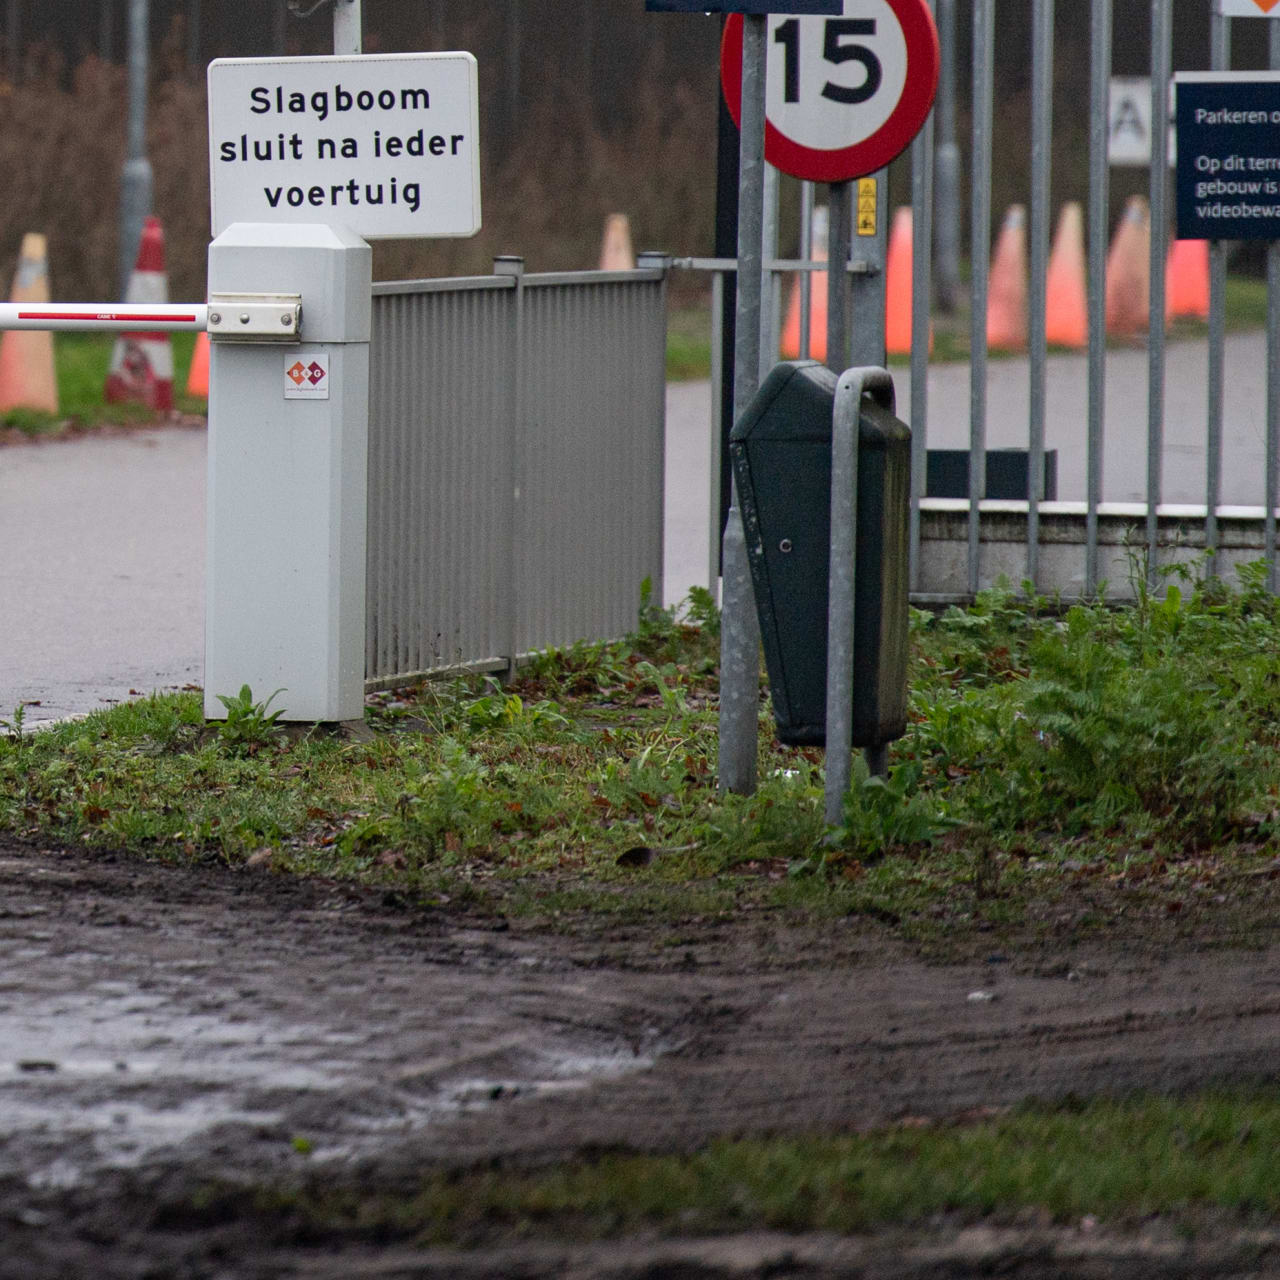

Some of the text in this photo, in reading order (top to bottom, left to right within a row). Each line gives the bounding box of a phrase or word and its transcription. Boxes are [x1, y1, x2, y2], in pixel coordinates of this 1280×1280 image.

[774, 18, 883, 105] 15
[250, 84, 430, 122] Slagboom
[1196, 108, 1268, 124] Parkeren
[220, 129, 465, 162] sluit na ieder
[1196, 155, 1221, 174] Op
[1223, 154, 1246, 171] dit
[263, 177, 421, 213] voertuig
[1196, 178, 1278, 198] gebouw is
